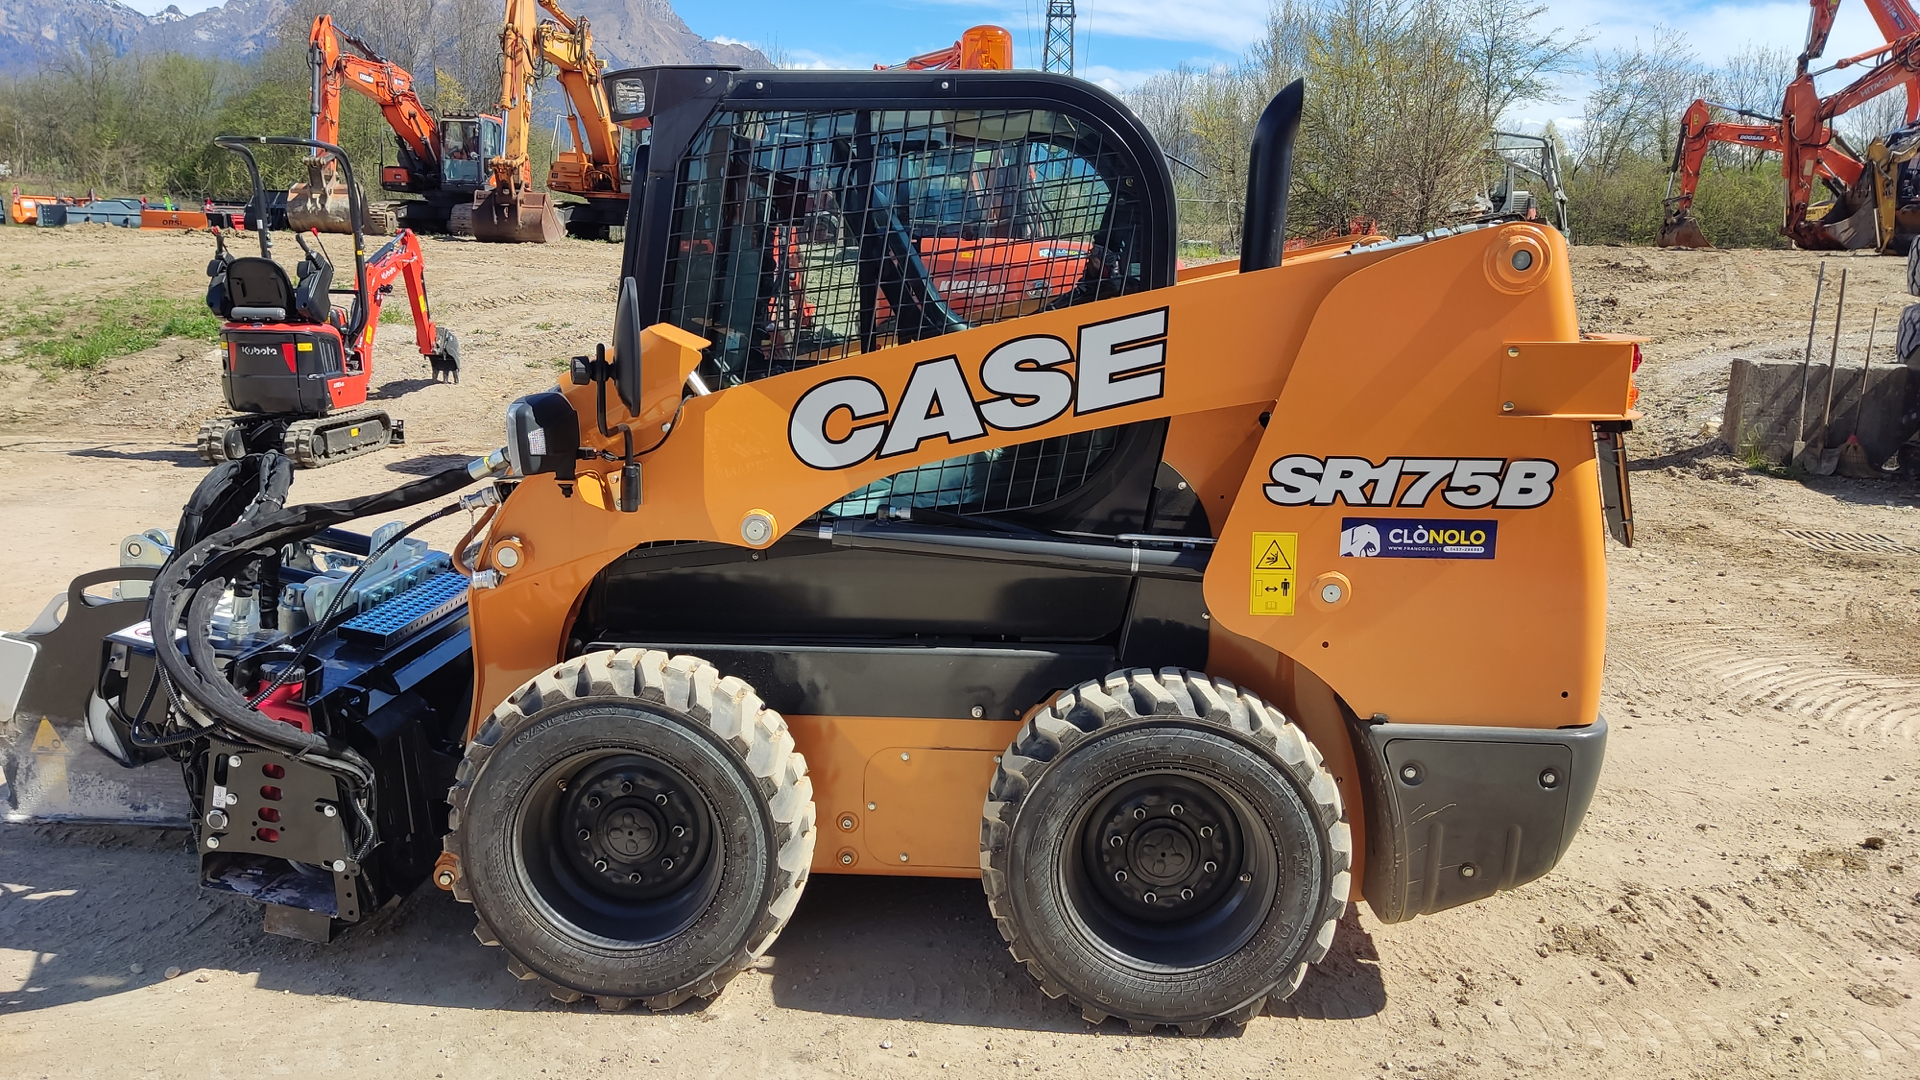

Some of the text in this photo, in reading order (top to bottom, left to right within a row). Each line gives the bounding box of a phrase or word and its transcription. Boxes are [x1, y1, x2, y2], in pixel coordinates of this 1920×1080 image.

[1861, 74, 1894, 97] HITACHI
[241, 346, 278, 356] Kubota
[788, 306, 1169, 470] CASE
[1263, 455, 1559, 509] SR175B
[1388, 525, 1486, 545] CLÒNOLO
